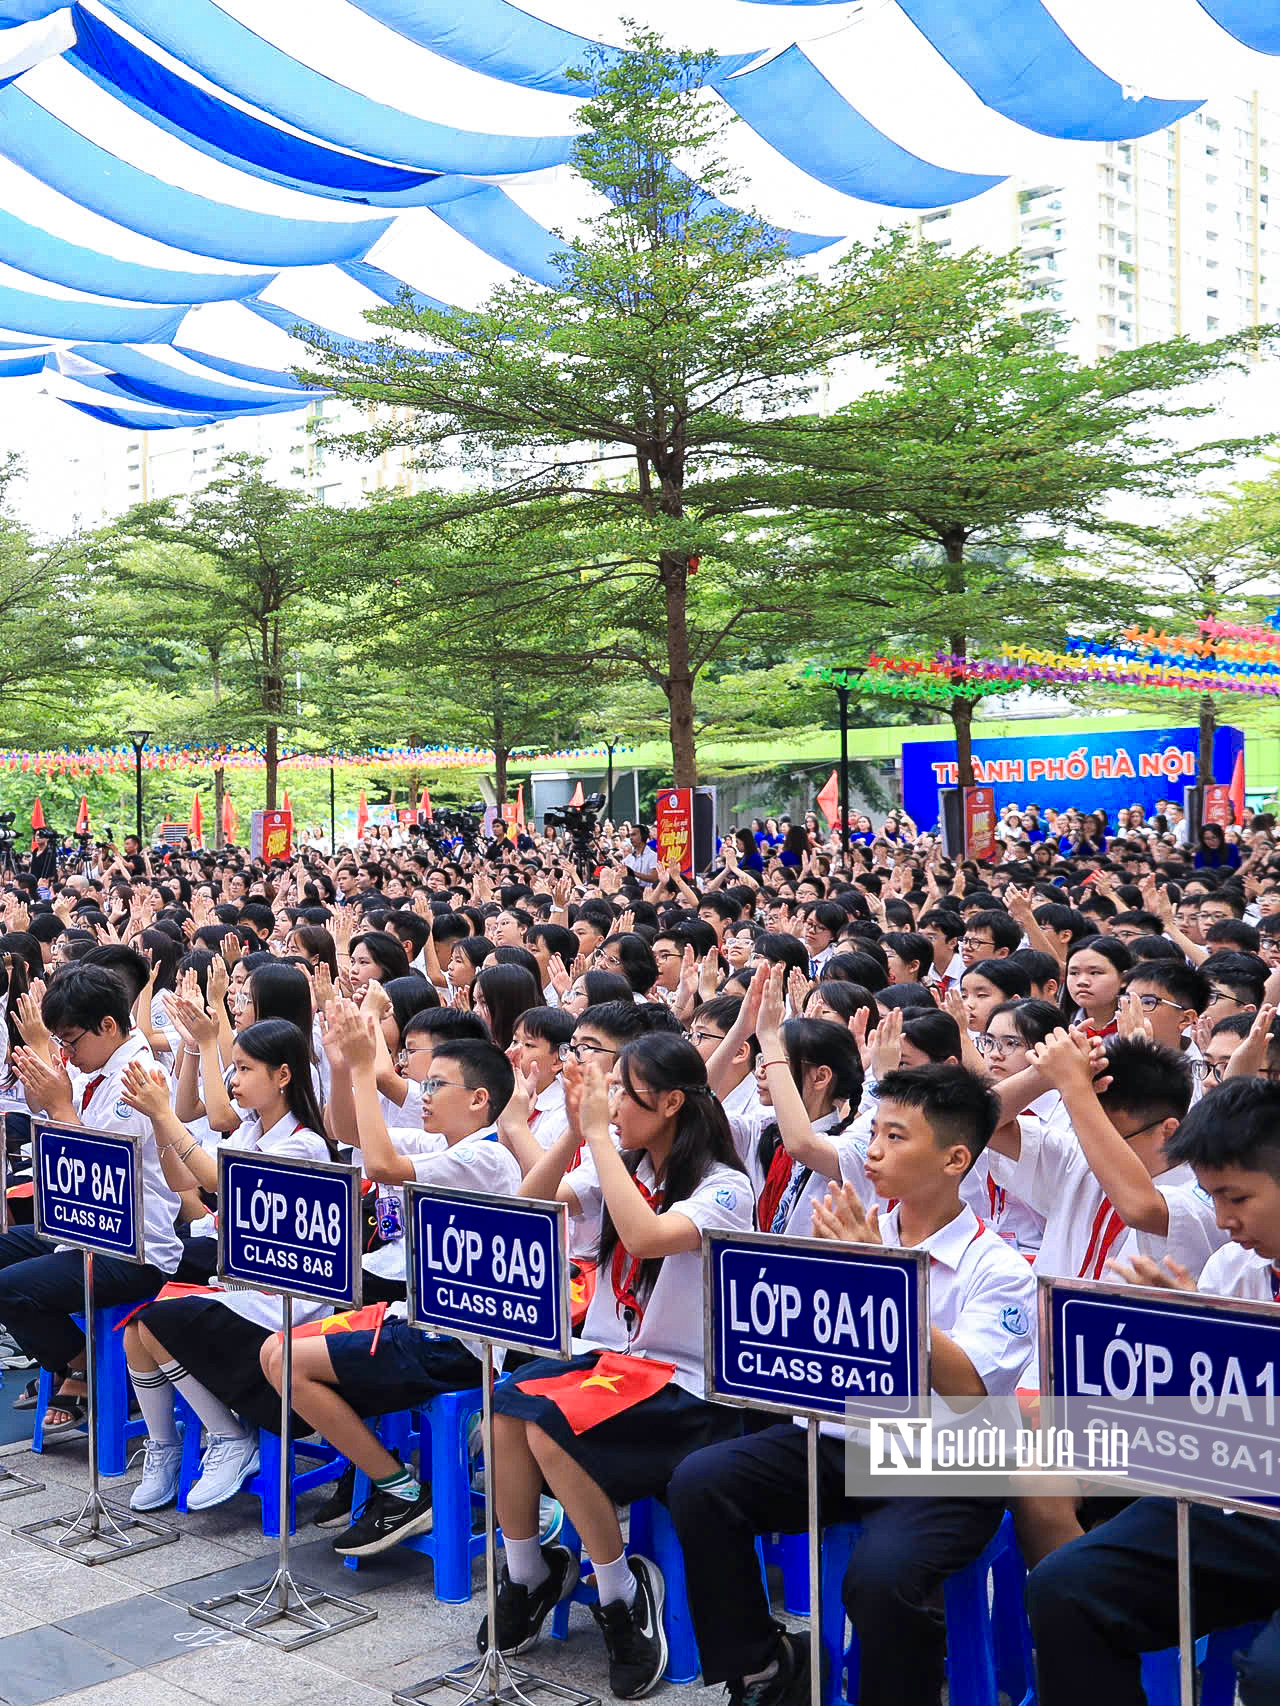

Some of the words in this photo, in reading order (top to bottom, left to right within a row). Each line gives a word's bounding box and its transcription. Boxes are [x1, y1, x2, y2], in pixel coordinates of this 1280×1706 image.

[1027, 747, 1089, 782] PHỐ
[1091, 748, 1137, 780] HÀ
[1138, 746, 1197, 783] NỘI
[45, 1146, 86, 1196] LỚP
[91, 1163, 126, 1205] 8A7
[54, 1204, 96, 1227] CLASS
[98, 1213, 122, 1234] 8A7
[235, 1178, 288, 1235] LỚP
[294, 1195, 342, 1248] 8A8
[243, 1243, 299, 1270] CLASS
[302, 1254, 334, 1279] 8A8
[426, 1214, 483, 1277] LỚP
[492, 1240, 546, 1290] 8A9
[436, 1287, 498, 1318] CLASS
[502, 1300, 539, 1326] 8A9
[729, 1266, 801, 1338] LỚP
[812, 1288, 900, 1354] 8A10
[737, 1350, 823, 1384] CLASS
[830, 1365, 895, 1396] 8A10
[1075, 1322, 1174, 1405] LỚP
[1087, 1418, 1200, 1461] CLASS
[1211, 1440, 1280, 1476] 8A1
